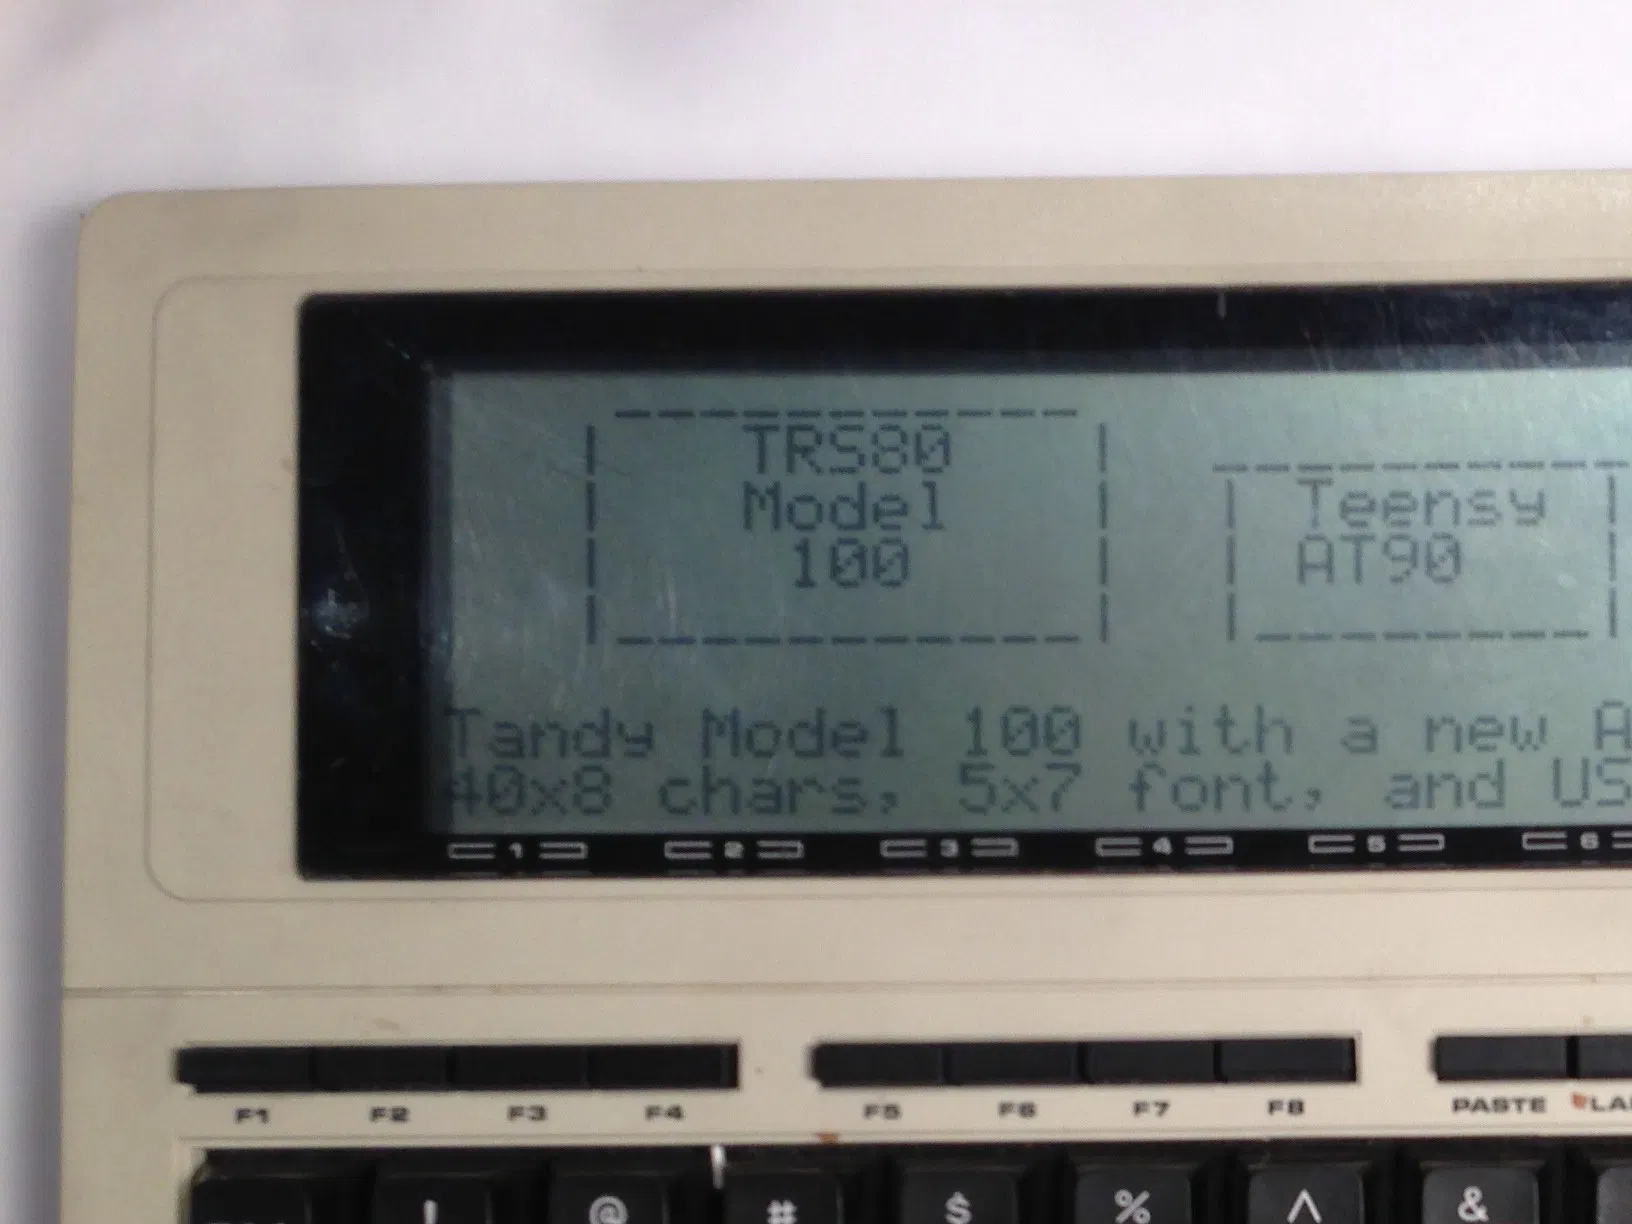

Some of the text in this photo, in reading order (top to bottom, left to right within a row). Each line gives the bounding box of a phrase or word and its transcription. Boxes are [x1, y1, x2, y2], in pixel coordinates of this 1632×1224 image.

[743, 424, 952, 475] TRS80
[743, 483, 946, 531] Model
[1297, 477, 1546, 527] Teensy
[792, 538, 910, 588] 100
[1297, 533, 1462, 585] AT90
[442, 707, 654, 760] Tandy
[701, 705, 904, 758] Model
[967, 704, 1082, 756] 100
[1130, 703, 1292, 755] with
[1341, 716, 1377, 753] a
[1425, 715, 1547, 752] new
[658, 763, 901, 816] chars,
[958, 762, 1082, 812] 5x7
[1130, 760, 1322, 813] font,
[1384, 757, 1505, 809] and
[234, 1107, 270, 1124] F1
[370, 1106, 409, 1123] F2
[507, 1104, 548, 1122] F3
[645, 1104, 685, 1121] F4
[863, 1103, 901, 1120] F5
[998, 1101, 1037, 1119] F6
[1132, 1100, 1171, 1117] F7
[1267, 1099, 1305, 1116] F8
[1451, 1096, 1546, 1114] PASTE
[1114, 1189, 1151, 1224] %
[1457, 1186, 1489, 1222] &
